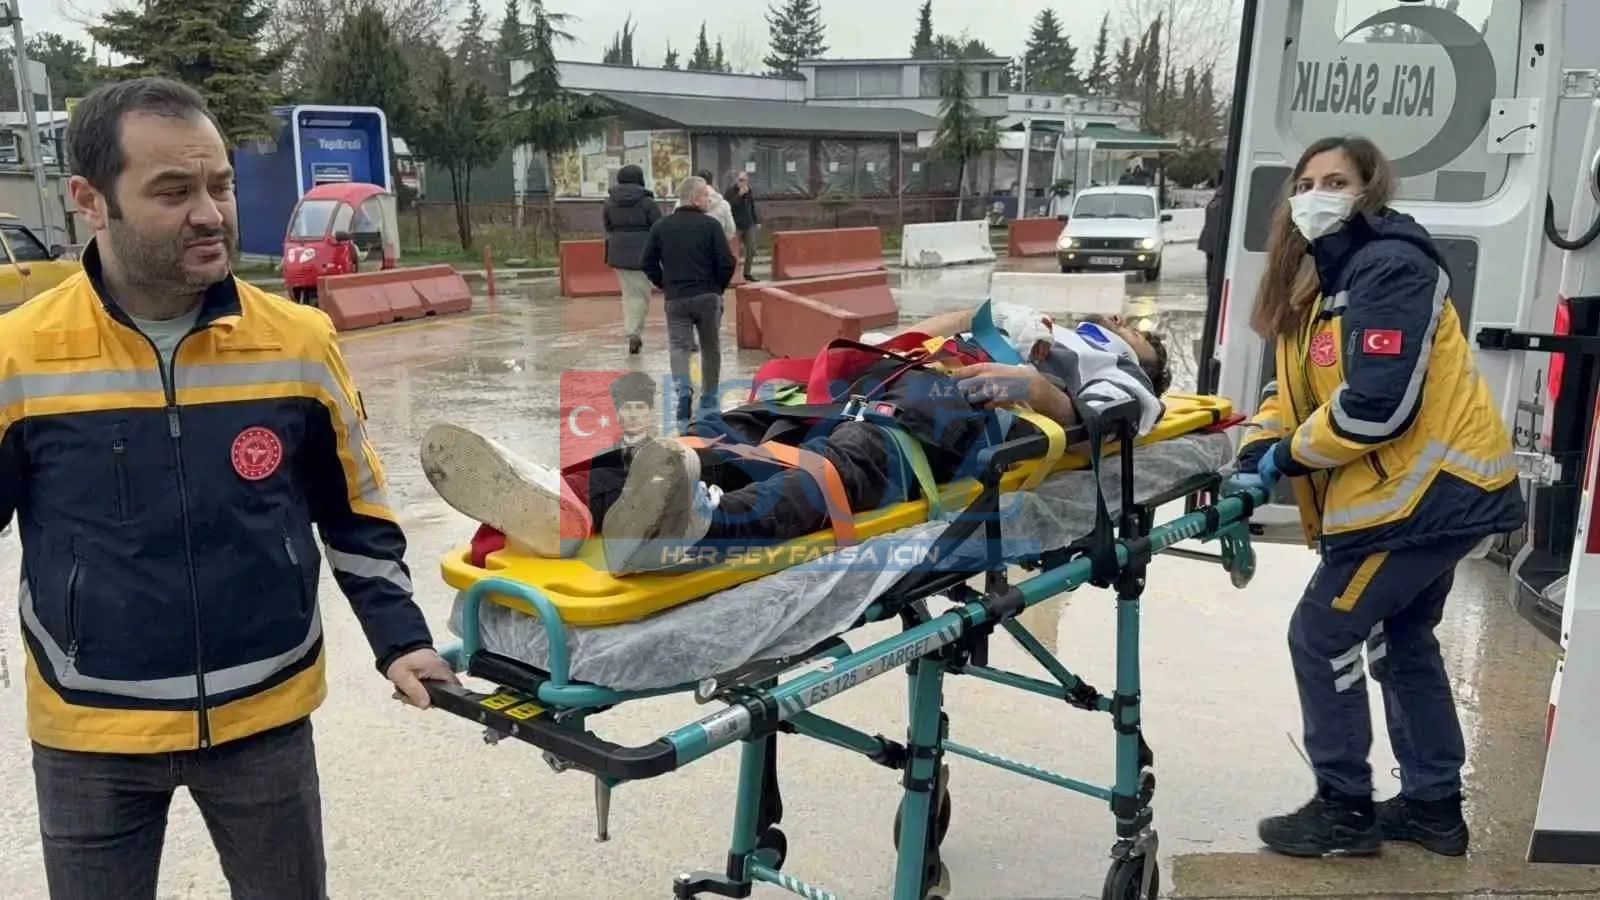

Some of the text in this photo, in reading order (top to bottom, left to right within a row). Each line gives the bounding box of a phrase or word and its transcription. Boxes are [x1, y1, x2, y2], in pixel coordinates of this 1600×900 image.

[809, 637, 932, 701] ES 125 TARGET
